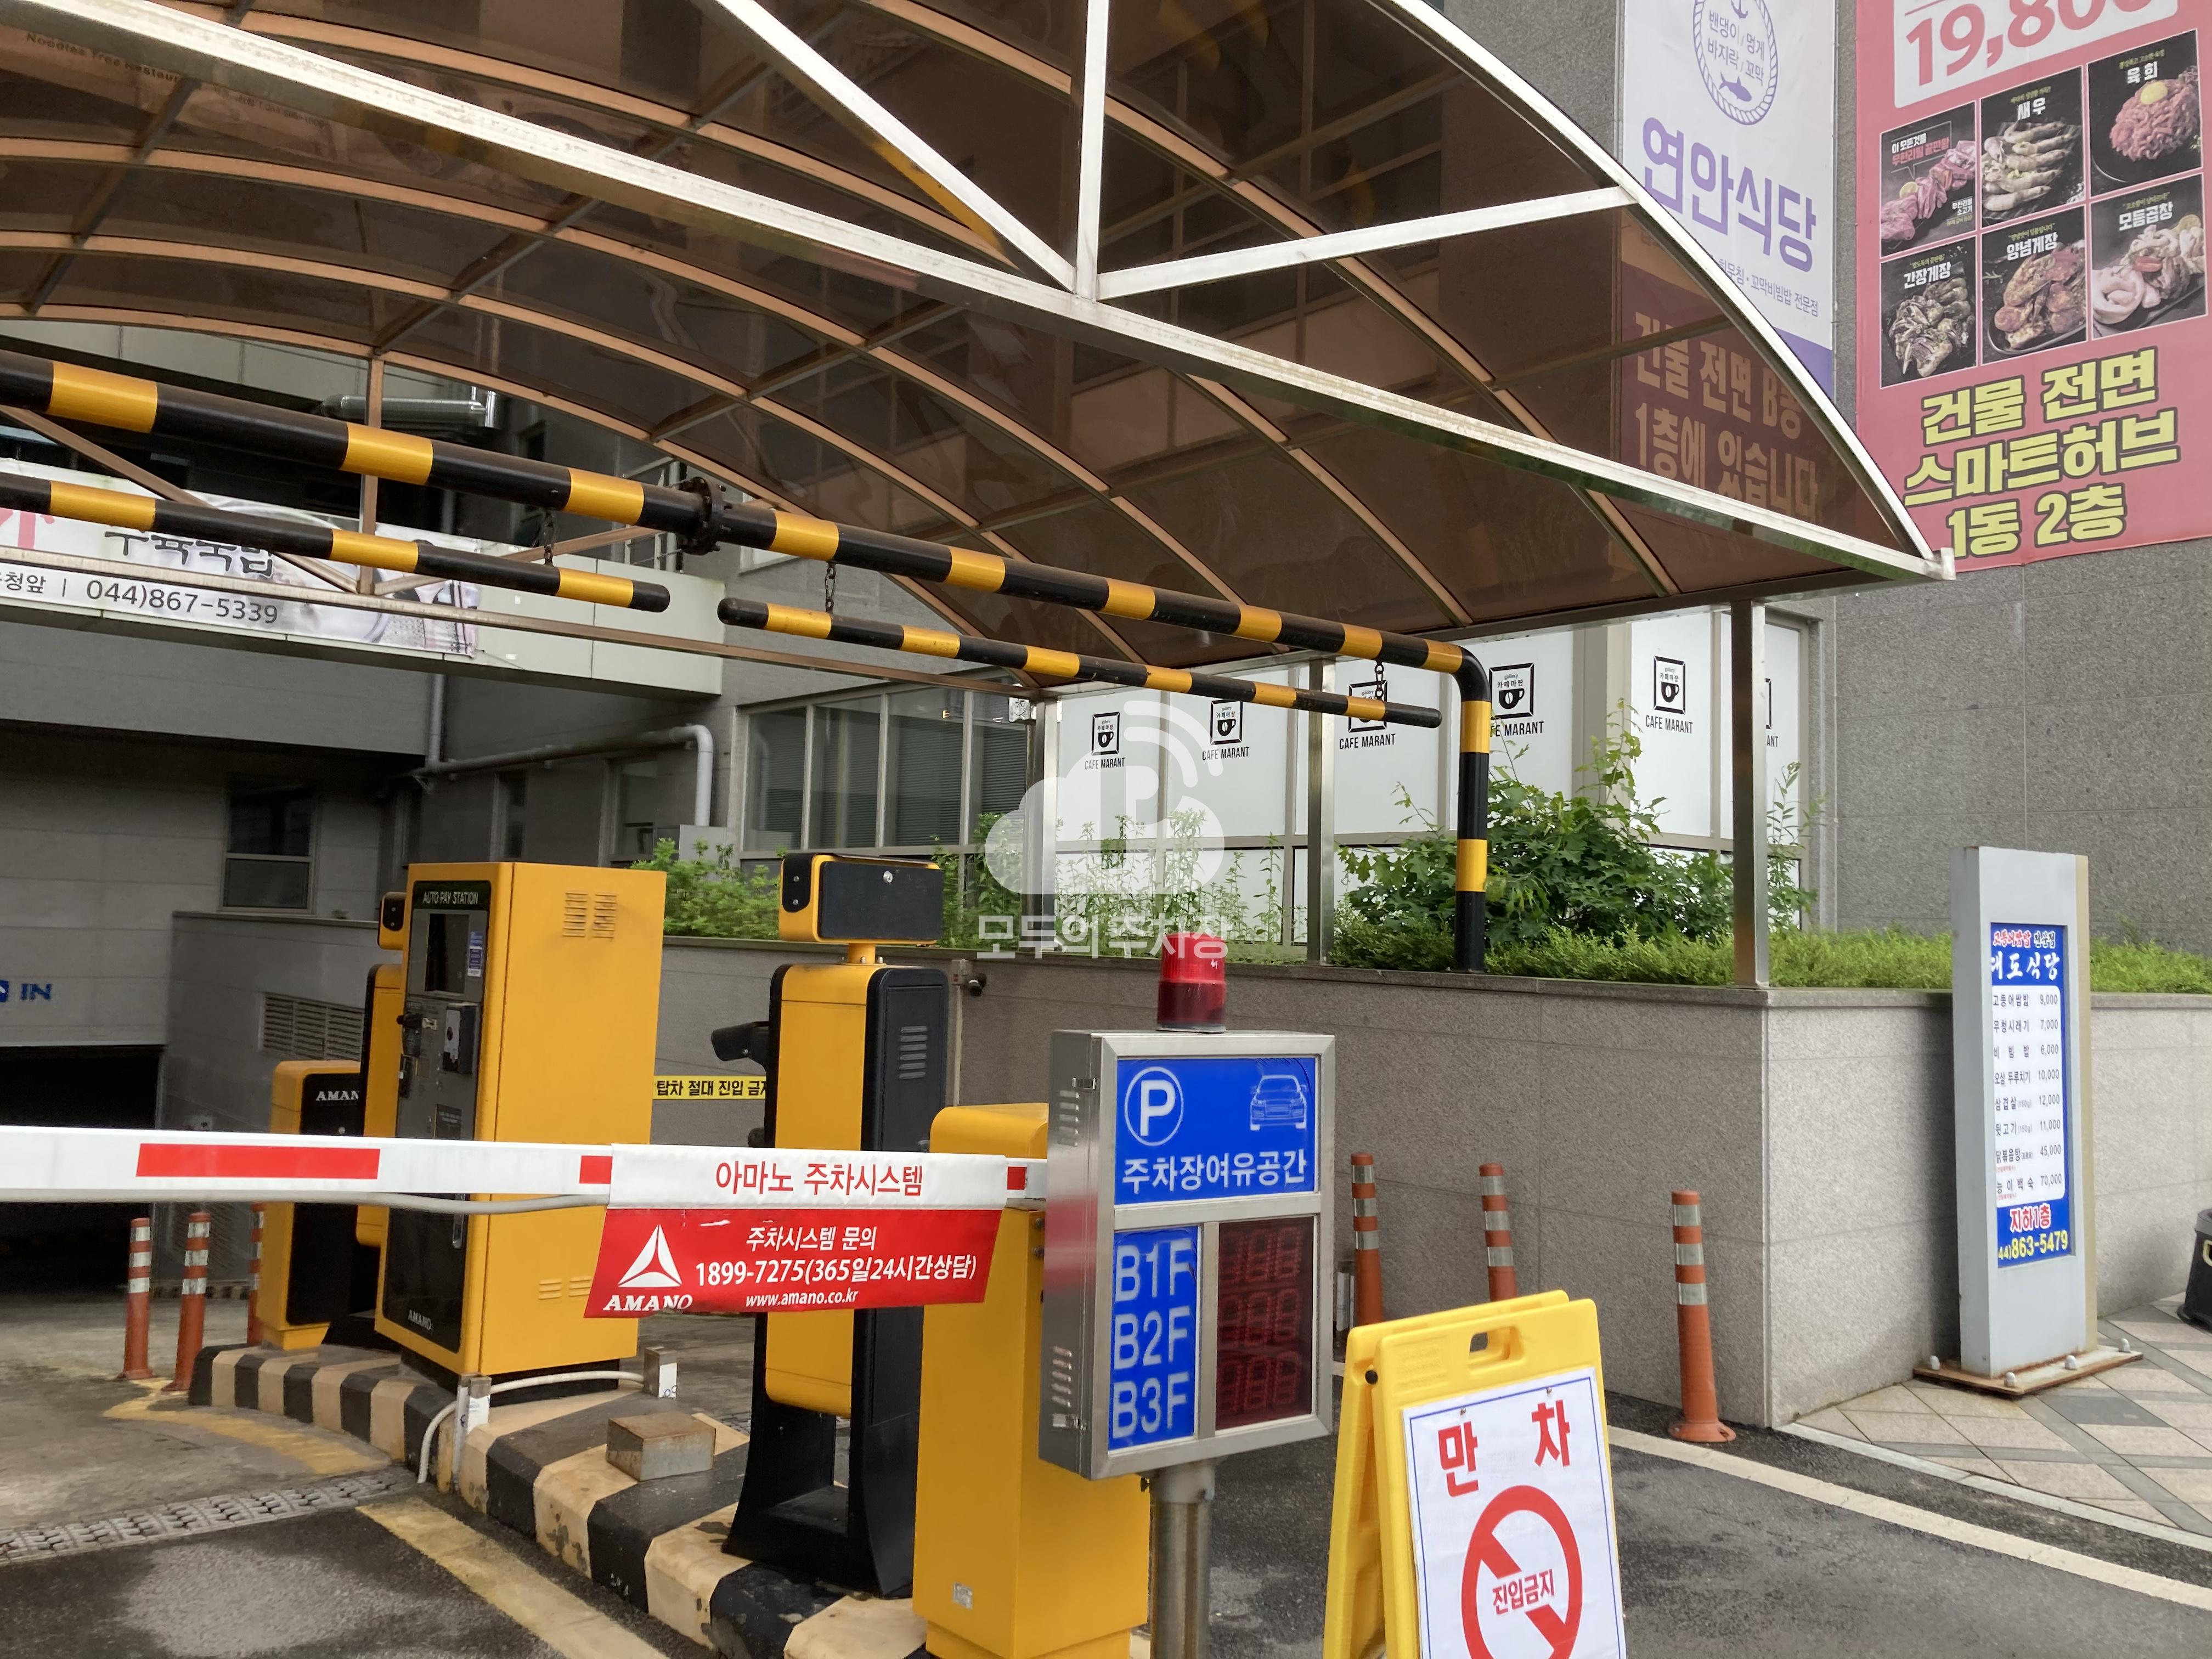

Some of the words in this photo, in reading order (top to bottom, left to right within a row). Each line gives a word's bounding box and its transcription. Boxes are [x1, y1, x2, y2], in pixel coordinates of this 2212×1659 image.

[1905, 0, 2151, 86] 19,80
[1643, 117, 1816, 273] 연안식당
[2007, 232, 2058, 261] 양념게장
[1904, 262, 1951, 289] 간장게장
[1751, 274, 1792, 306] 꼬막비빔밥
[1795, 292, 1818, 318] 전문점
[1635, 311, 1689, 399] 건물
[1699, 340, 1751, 423] 전면
[1922, 377, 2024, 446] 건물
[2042, 348, 2157, 421] 전면
[1635, 402, 1706, 489] 1층에
[1718, 430, 1819, 520] 있습니다
[1904, 409, 2178, 507] 스마트허브
[1948, 500, 2020, 558] 1동
[2036, 484, 2125, 546] 2층
[0, 571, 46, 594] 청앞
[86, 579, 278, 624] 044)867-5339
[1504, 721, 1544, 736] MARANT
[1645, 715, 1663, 729] CAFE
[1665, 718, 1693, 734] MARANT
[1202, 749, 1218, 760] CAFE
[1221, 746, 1250, 759] MARANT
[1339, 737, 1358, 749] CAFE
[1362, 733, 1396, 747] MARANT
[1767, 735, 1779, 747] ANT
[1085, 759, 1099, 770] CAFE
[1101, 757, 1125, 769] MARANT
[422, 891, 439, 904] AUTO
[440, 891, 452, 904] PAY
[453, 891, 479, 905] STATION
[2040, 994, 2058, 1006] 9,000
[2040, 1019, 2058, 1032] 7,000
[2041, 1044, 2059, 1057] 6,000
[657, 1080, 684, 1096] 탑차
[688, 1080, 714, 1096] 절대
[718, 1080, 743, 1096] 진입
[1995, 1071, 2005, 1085] 오삼
[2008, 1070, 2030, 1085] 두루치기
[2039, 1069, 2059, 1082] 10,000
[315, 1090, 359, 1101] AMAN
[2039, 1094, 2060, 1107] 12,000
[1140, 1079, 1176, 1137] P
[2040, 1119, 2061, 1132] 11,000
[2040, 1144, 2062, 1158] 45,000
[716, 1161, 794, 1195] 아마노
[804, 1161, 924, 1197] 주차시스템
[1122, 1148, 1308, 1194] 주차장여유공간
[2040, 1173, 2062, 1187] 70,000
[2010, 1203, 2051, 1233] 지하1층
[745, 1226, 836, 1252] 주차시스템
[841, 1225, 877, 1251] 문의
[1115, 1237, 1194, 1304] B1F
[602, 1294, 693, 1311] AMANO
[746, 1288, 859, 1309] www.amano.co.kr
[408, 1309, 432, 1331] AMANO
[1114, 1305, 1192, 1371] B2F
[1112, 1371, 1190, 1439] B3F
[1492, 1568, 1555, 1616] 진입금지
